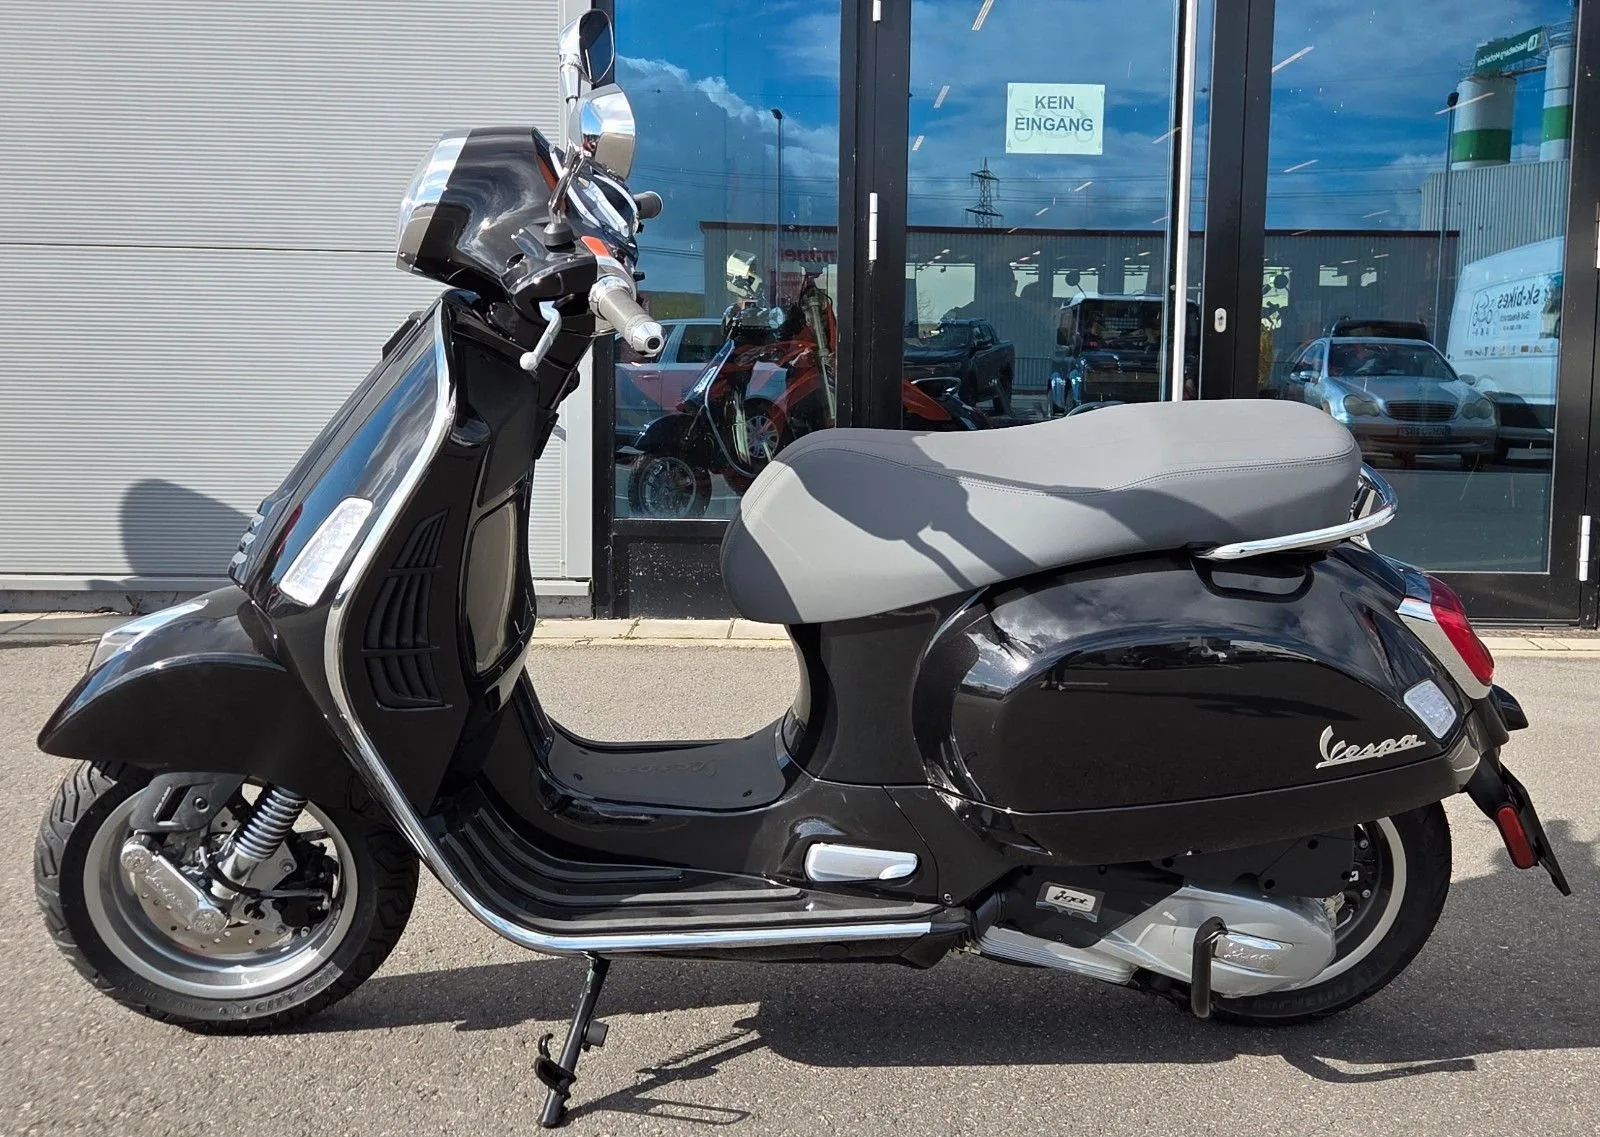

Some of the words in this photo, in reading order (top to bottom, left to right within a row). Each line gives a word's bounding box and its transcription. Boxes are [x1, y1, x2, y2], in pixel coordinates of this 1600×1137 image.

[1035, 95, 1074, 110] KEIN
[1015, 117, 1094, 131] EINGANG
[1315, 725, 1426, 769] Vespa
